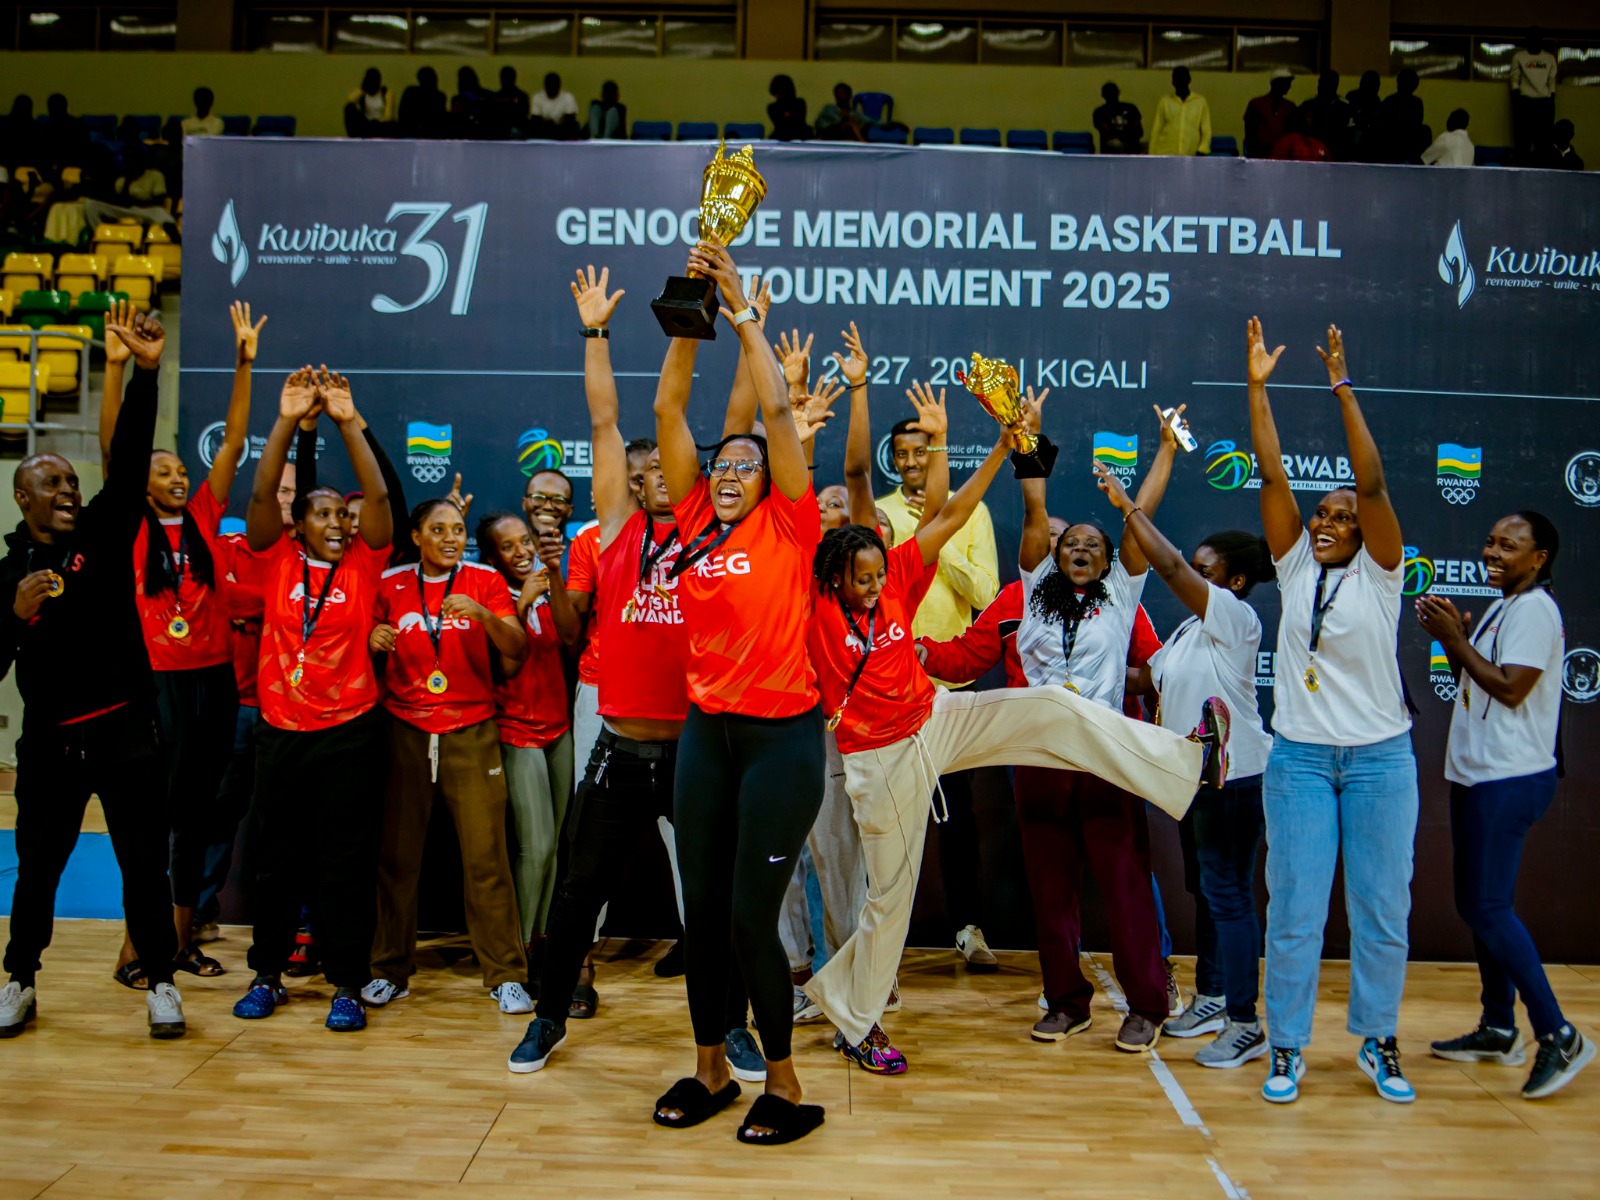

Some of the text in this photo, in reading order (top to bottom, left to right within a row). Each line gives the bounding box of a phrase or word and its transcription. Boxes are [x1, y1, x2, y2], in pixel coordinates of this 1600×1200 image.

[258, 222, 397, 251] Kwibuka
[793, 210, 1037, 250] MEMORIAL
[1050, 213, 1342, 258] BASKETBALL
[258, 254, 314, 264] remember
[371, 202, 488, 315] 31
[1486, 246, 1600, 277] Kwibuk
[736, 266, 1170, 310] TOURNAMENT 2025
[1485, 278, 1543, 288] remember
[1554, 280, 1580, 290] unite
[1037, 358, 1147, 389] KIGALI
[406, 456, 451, 466] RWANDA
[1093, 466, 1137, 476] RANDA
[1436, 478, 1480, 488] RWANDA
[1461, 588, 1501, 596] BASKETBAL
